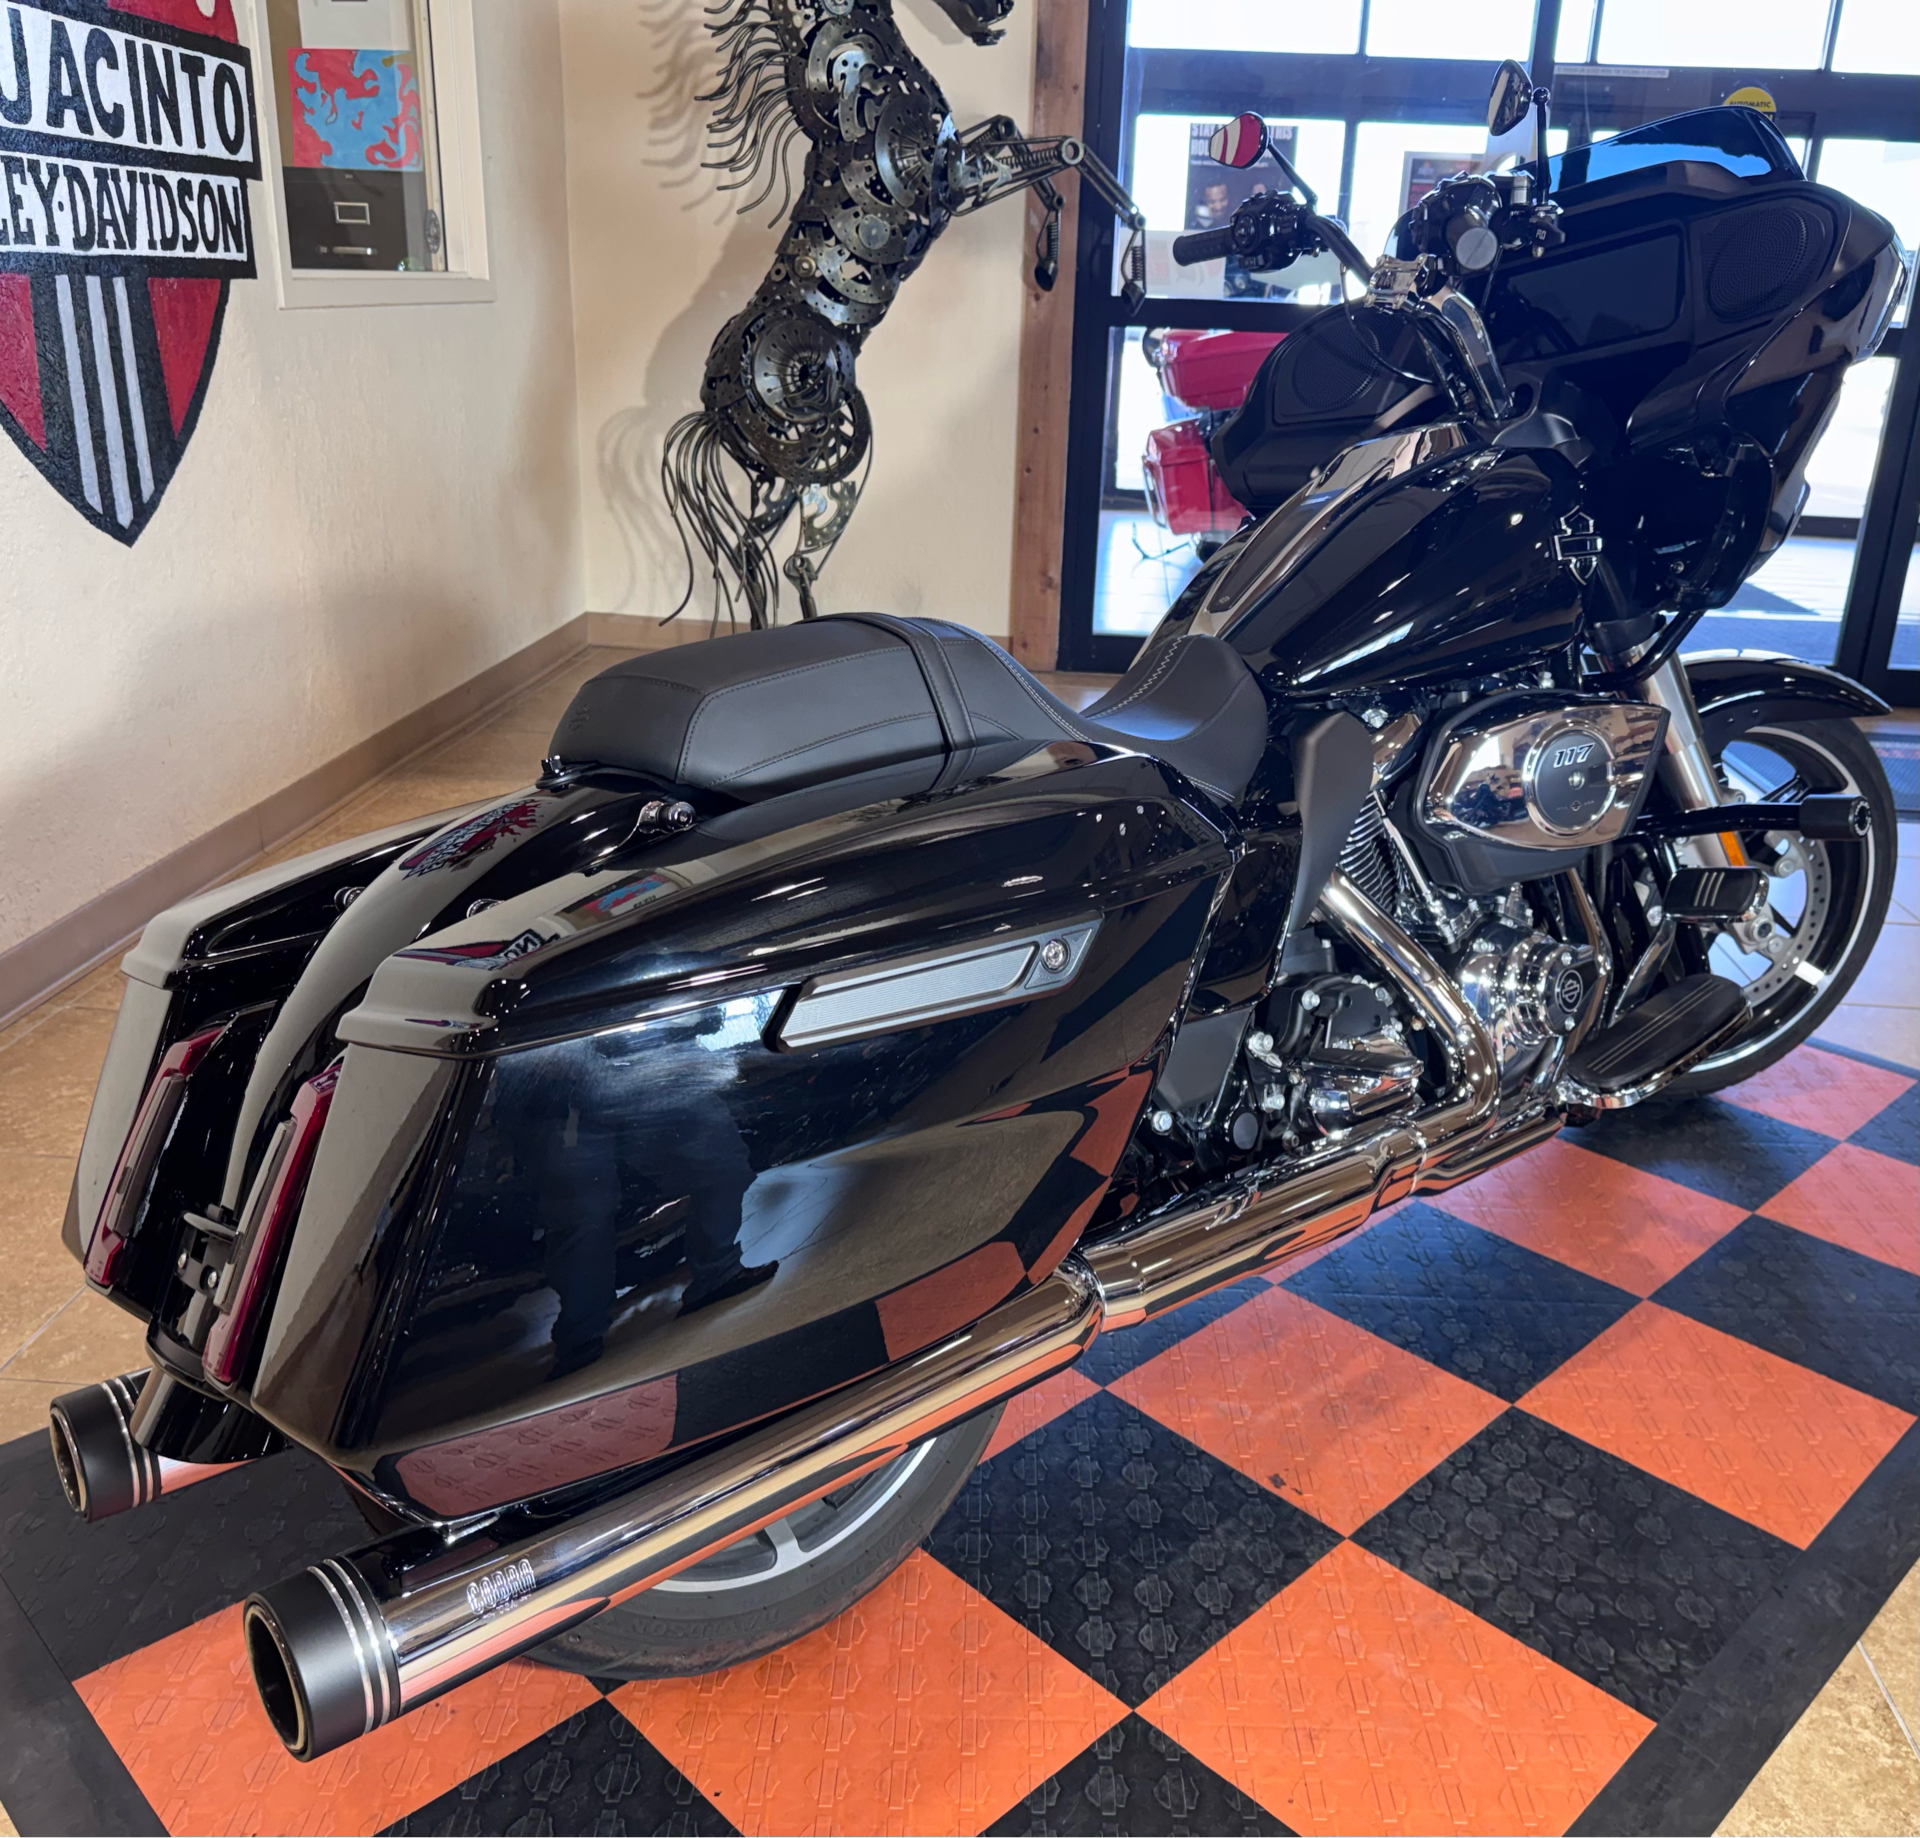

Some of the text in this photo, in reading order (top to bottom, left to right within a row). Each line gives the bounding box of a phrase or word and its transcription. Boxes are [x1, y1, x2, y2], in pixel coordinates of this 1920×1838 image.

[0, 6, 246, 156] JACINTO
[1553, 742, 1596, 769] 117
[466, 1558, 537, 1615] COBRA
